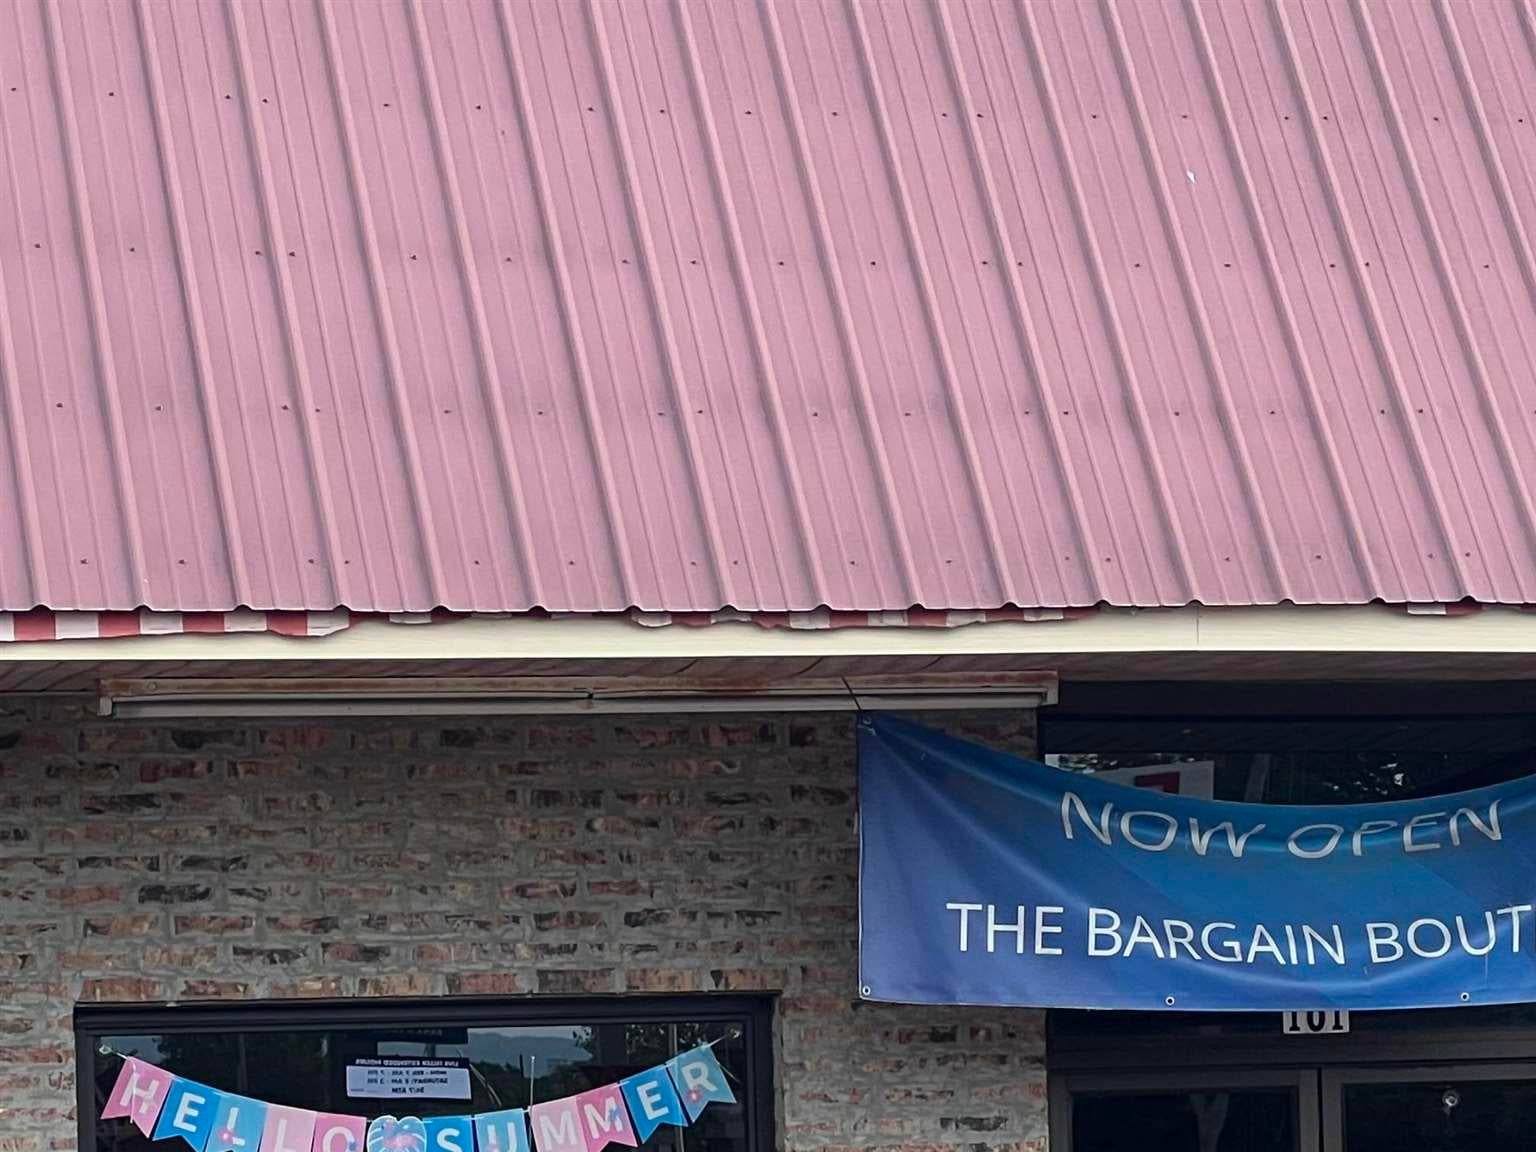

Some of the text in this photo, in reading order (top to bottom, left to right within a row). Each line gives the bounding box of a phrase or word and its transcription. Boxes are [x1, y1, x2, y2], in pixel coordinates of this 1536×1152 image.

[1061, 791, 1503, 859] NOW OPEN
[946, 902, 1064, 956] THE
[1088, 906, 1346, 965] BARGAIN
[1288, 1010, 1344, 1032] 101
